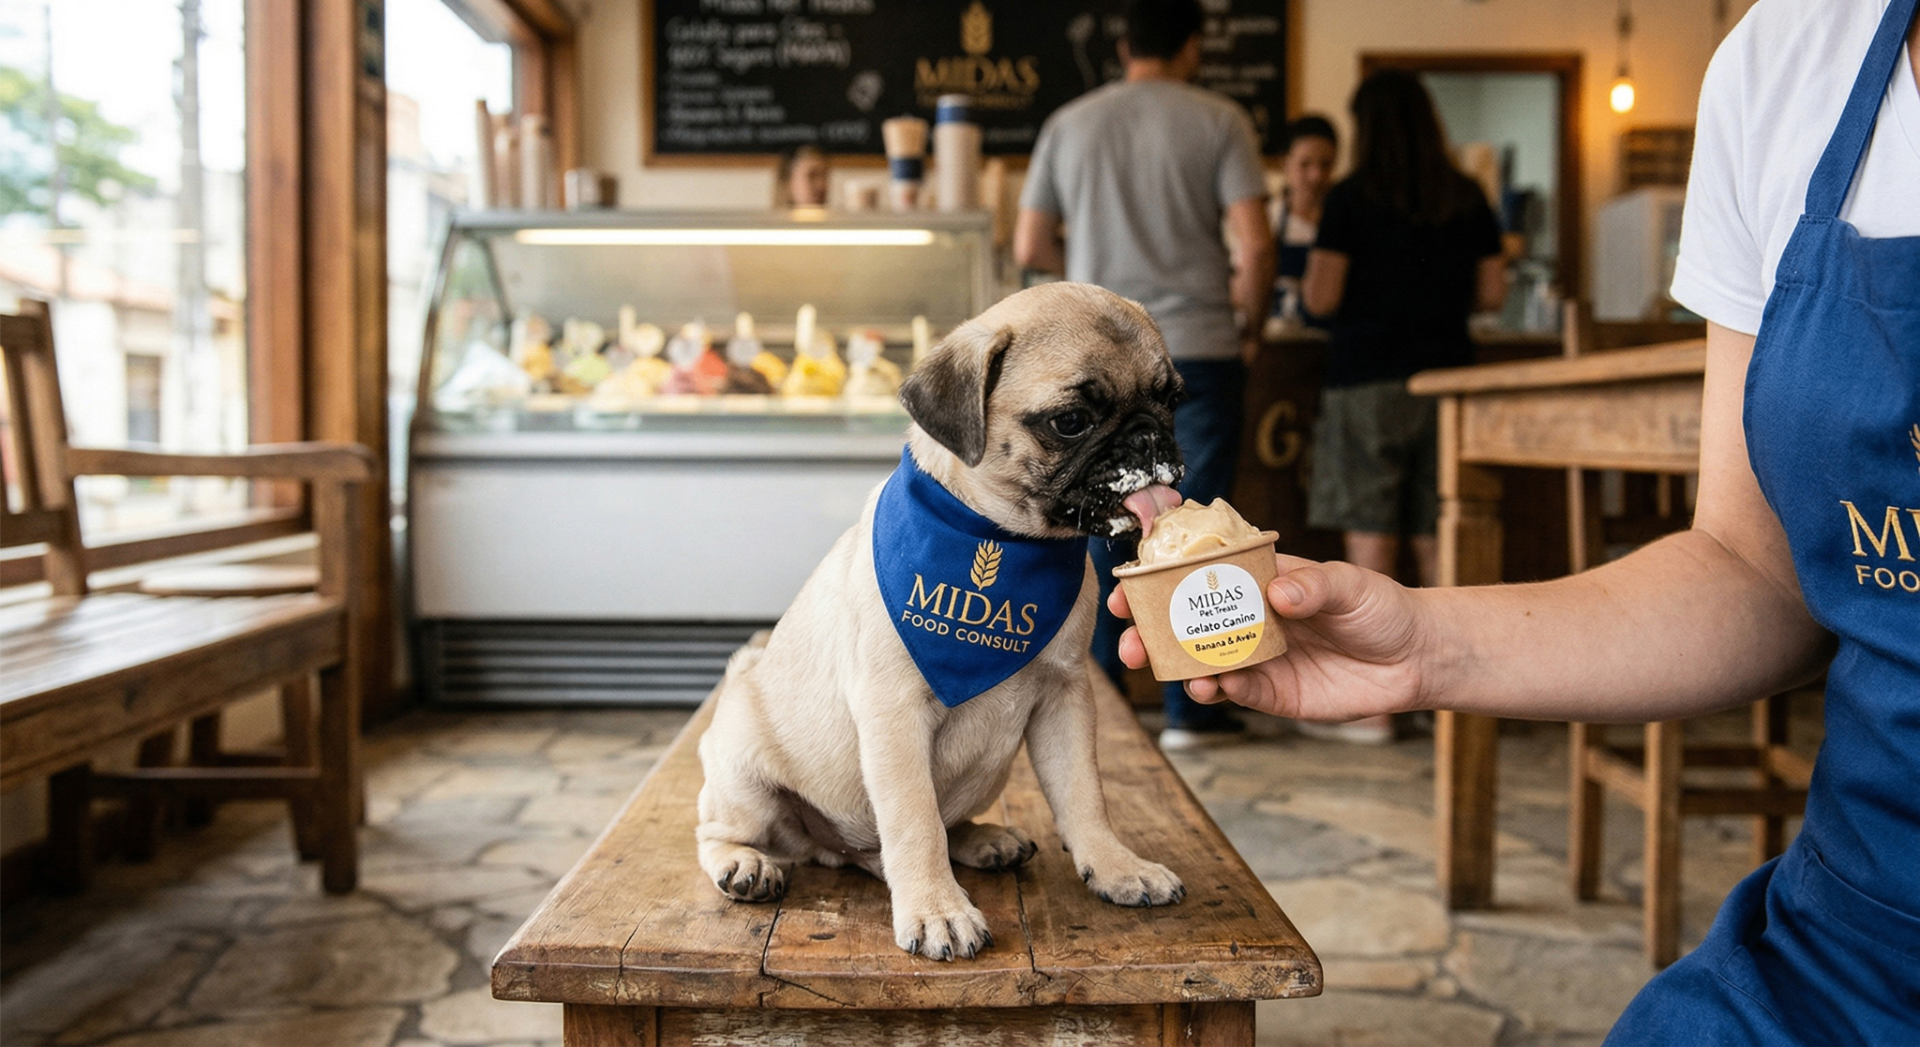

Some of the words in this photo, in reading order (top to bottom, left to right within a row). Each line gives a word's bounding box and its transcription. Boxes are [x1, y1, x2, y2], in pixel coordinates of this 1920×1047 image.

[916, 57, 1039, 92] MIDAS
[905, 573, 1038, 636] MIDAS
[1188, 585, 1244, 611] MIDAS
[1199, 609, 1213, 617] Pet
[1214, 604, 1238, 613] Treats
[901, 610, 950, 636] FOOD
[955, 628, 1031, 653] CONSULT
[1186, 623, 1221, 636] Gelato
[1222, 613, 1256, 628] Canino
[1195, 640, 1226, 651] Banana
[1228, 637, 1234, 645] &
